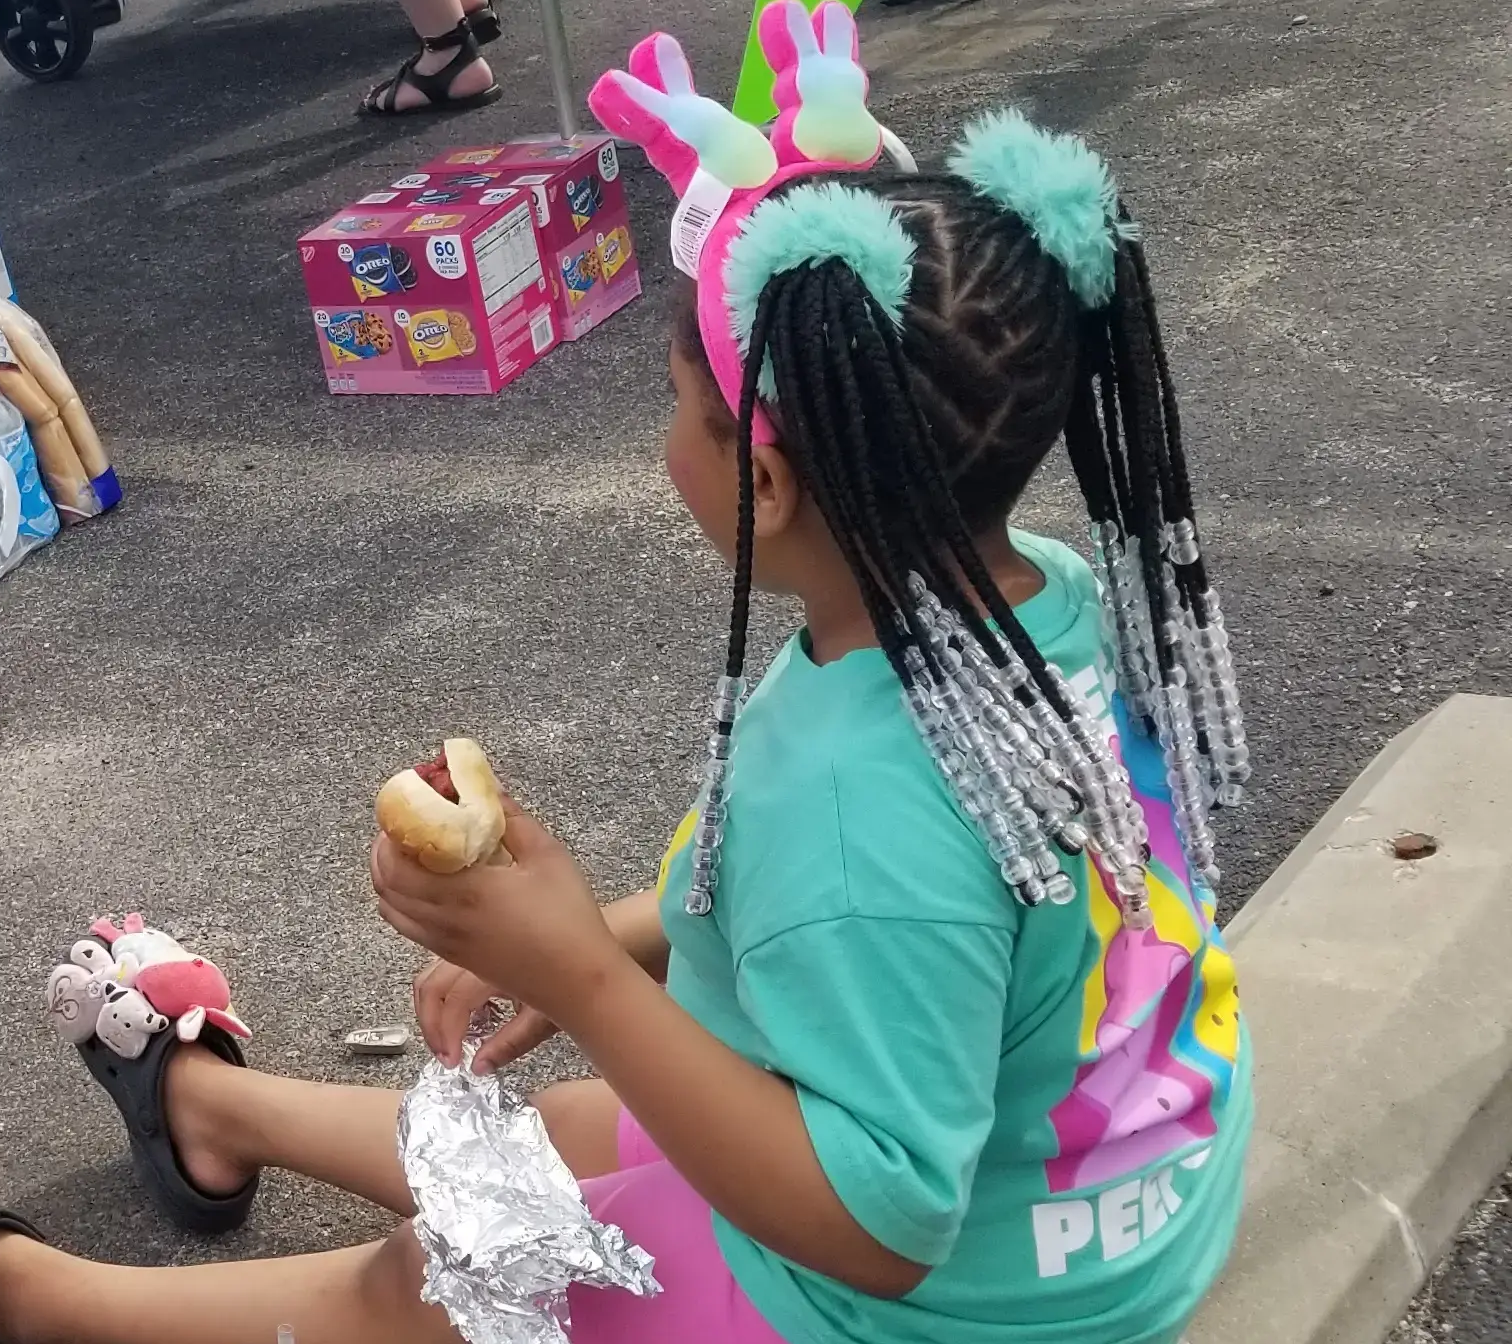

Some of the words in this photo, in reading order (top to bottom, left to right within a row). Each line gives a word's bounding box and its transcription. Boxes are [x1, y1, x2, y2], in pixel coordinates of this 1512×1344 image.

[600, 147, 614, 165] 60
[433, 240, 456, 257] 60
[355, 258, 390, 275] OREO
[435, 256, 459, 266] PACKS
[413, 325, 449, 341] OREO
